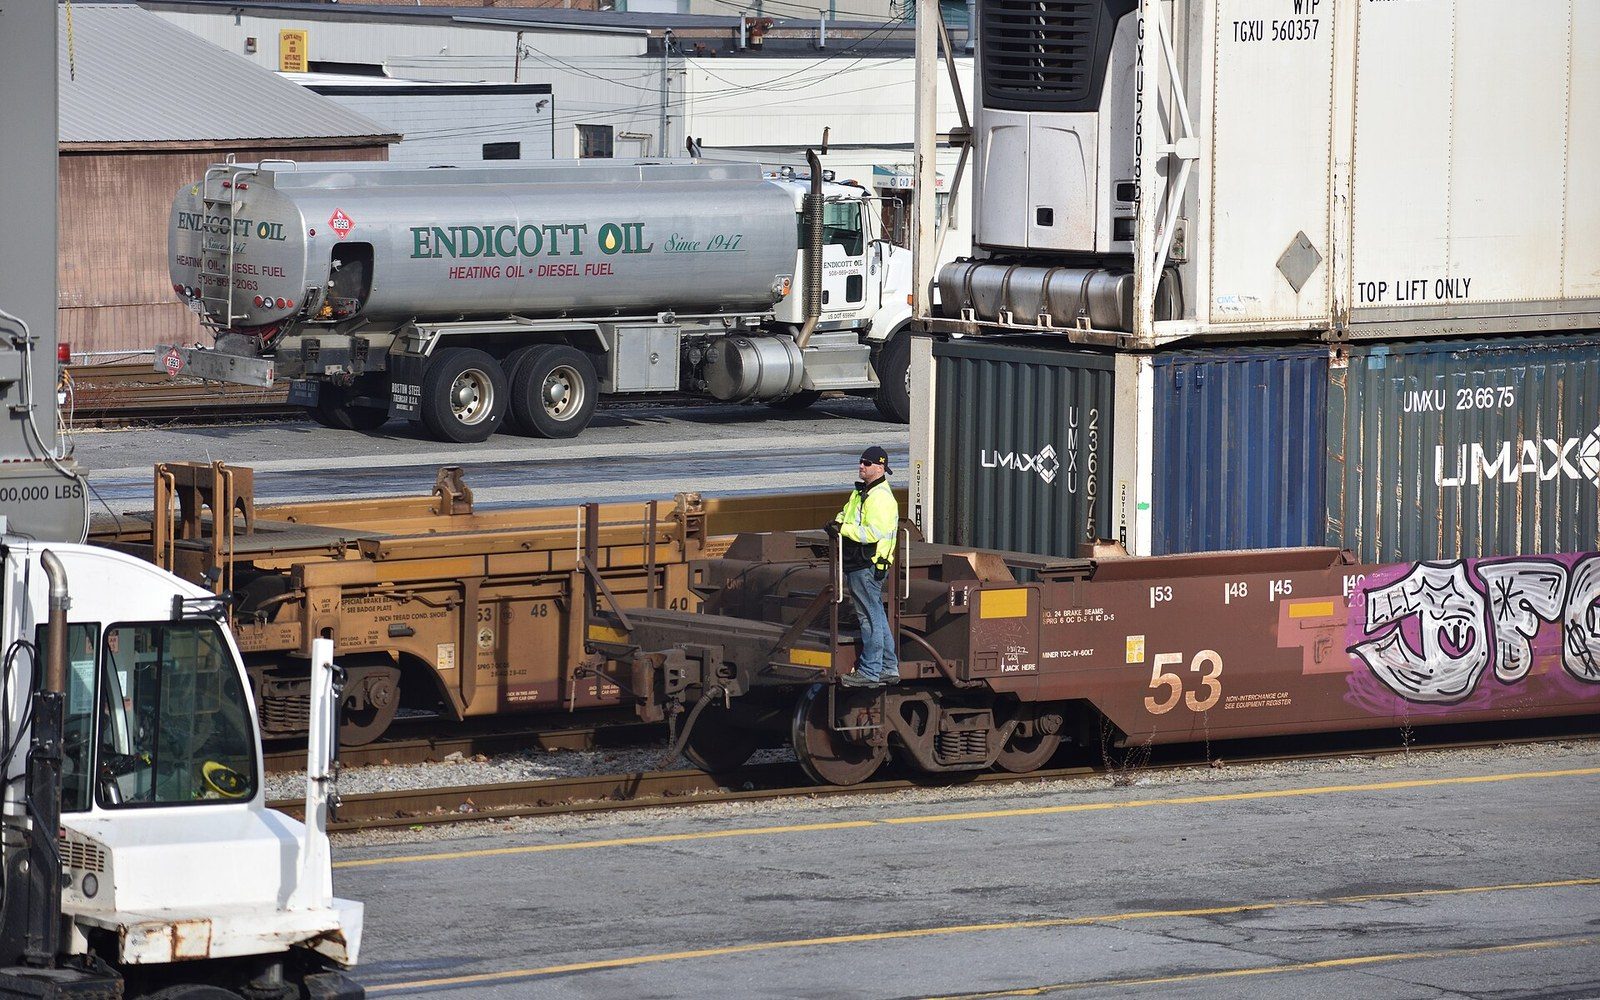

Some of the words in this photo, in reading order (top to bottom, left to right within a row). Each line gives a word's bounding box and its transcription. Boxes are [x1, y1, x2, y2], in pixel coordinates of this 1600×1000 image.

[1233, 20, 1263, 42] TGXU
[1272, 19, 1319, 41] 560357
[257, 222, 286, 241] OIL
[410, 223, 587, 258] ENDICOTT
[598, 222, 654, 254] OIL
[664, 232, 700, 251] Since
[706, 234, 742, 250] 1947
[176, 255, 202, 268] HEATING
[207, 260, 220, 271] OIL
[262, 266, 286, 277] FUEL
[449, 266, 500, 279] HEATING
[506, 264, 524, 278] OIL
[538, 264, 580, 277] DIESEL
[584, 263, 615, 276] FUEL
[1358, 282, 1387, 302] TOP
[1396, 280, 1428, 301] LIFT
[1435, 278, 1472, 299] ONLY
[408, 385, 421, 396] STEEL
[1404, 390, 1446, 412] UMXU
[1068, 406, 1078, 493] UMXU
[981, 450, 1038, 472] UMAX
[1435, 438, 1582, 486] UMAX
[1086, 408, 1099, 539] 236675
[1155, 586, 1172, 601] 53
[1230, 583, 1248, 597] 48
[1275, 580, 1292, 594] 45
[531, 604, 548, 618] 48
[670, 598, 687, 611] 40
[1144, 650, 1223, 715] 53
[1226, 694, 1273, 702] NON-INTERCHANGE
[1235, 701, 1264, 709] EQUIPMENT
